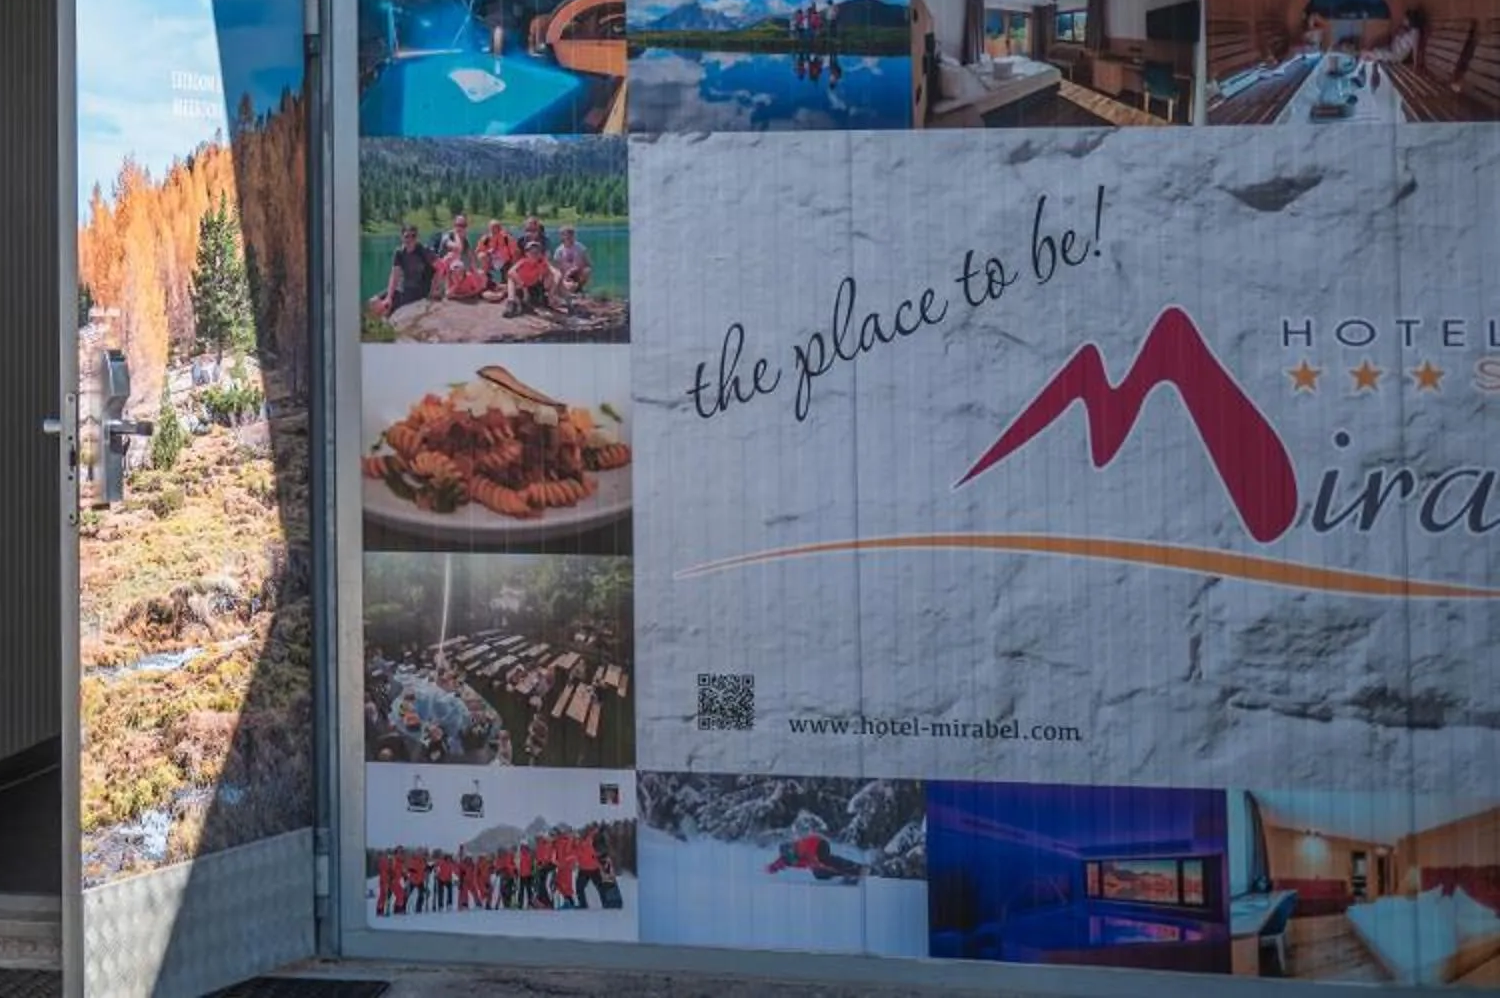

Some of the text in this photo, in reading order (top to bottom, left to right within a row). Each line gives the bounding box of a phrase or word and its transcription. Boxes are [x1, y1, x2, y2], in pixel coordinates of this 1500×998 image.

[687, 184, 1106, 422] the place to be!
[1282, 318, 1500, 348] HOTEL
[788, 715, 1083, 742] www.hotel-mirabel.com
